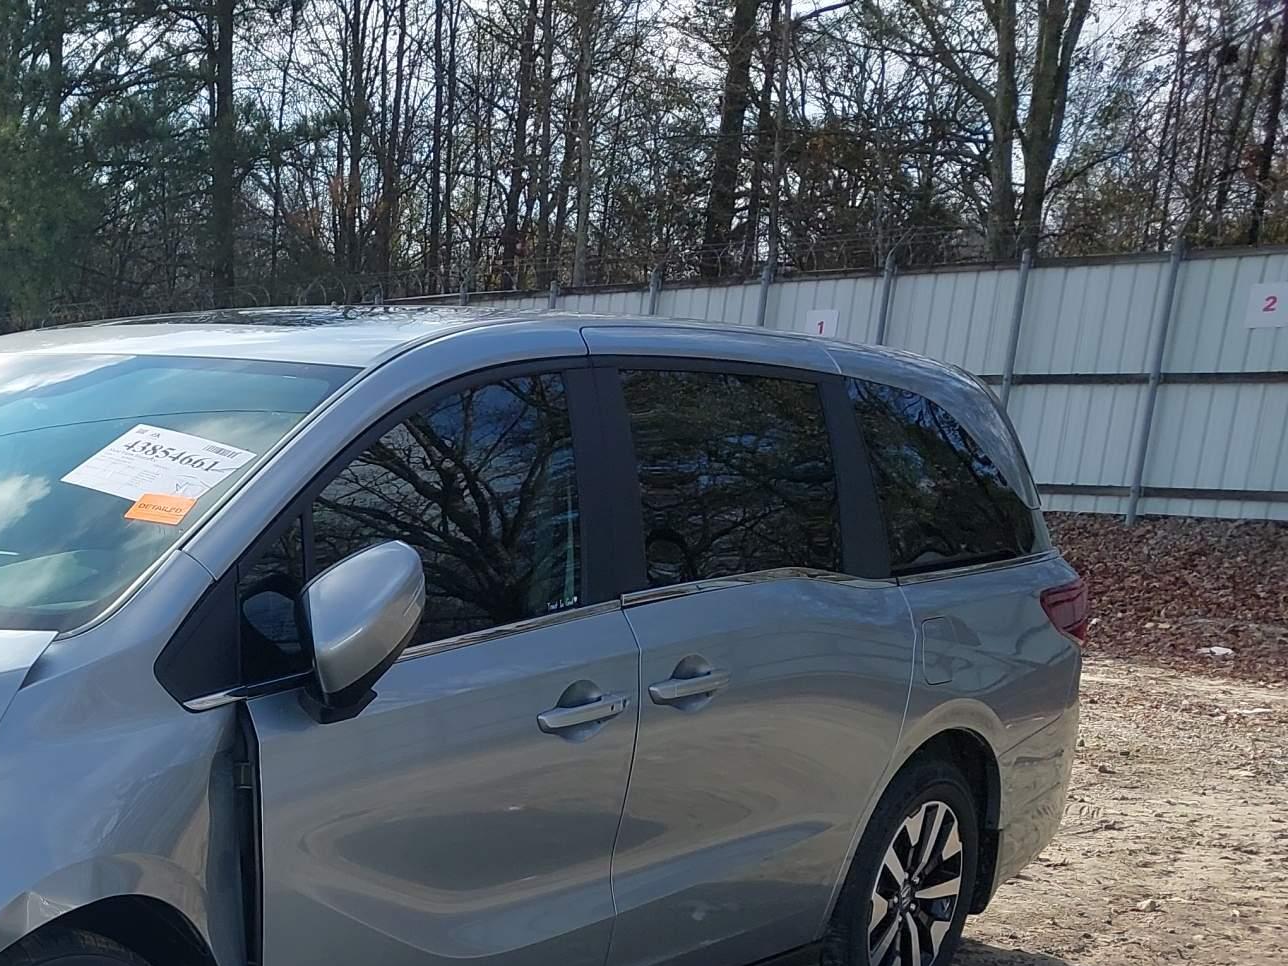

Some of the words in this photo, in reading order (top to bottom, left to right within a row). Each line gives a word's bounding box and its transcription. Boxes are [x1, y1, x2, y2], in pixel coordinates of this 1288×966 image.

[1262, 295, 1278, 312] 2
[817, 321, 824, 334] 1
[124, 440, 220, 472] 43854661
[137, 502, 183, 514] DETAILED
